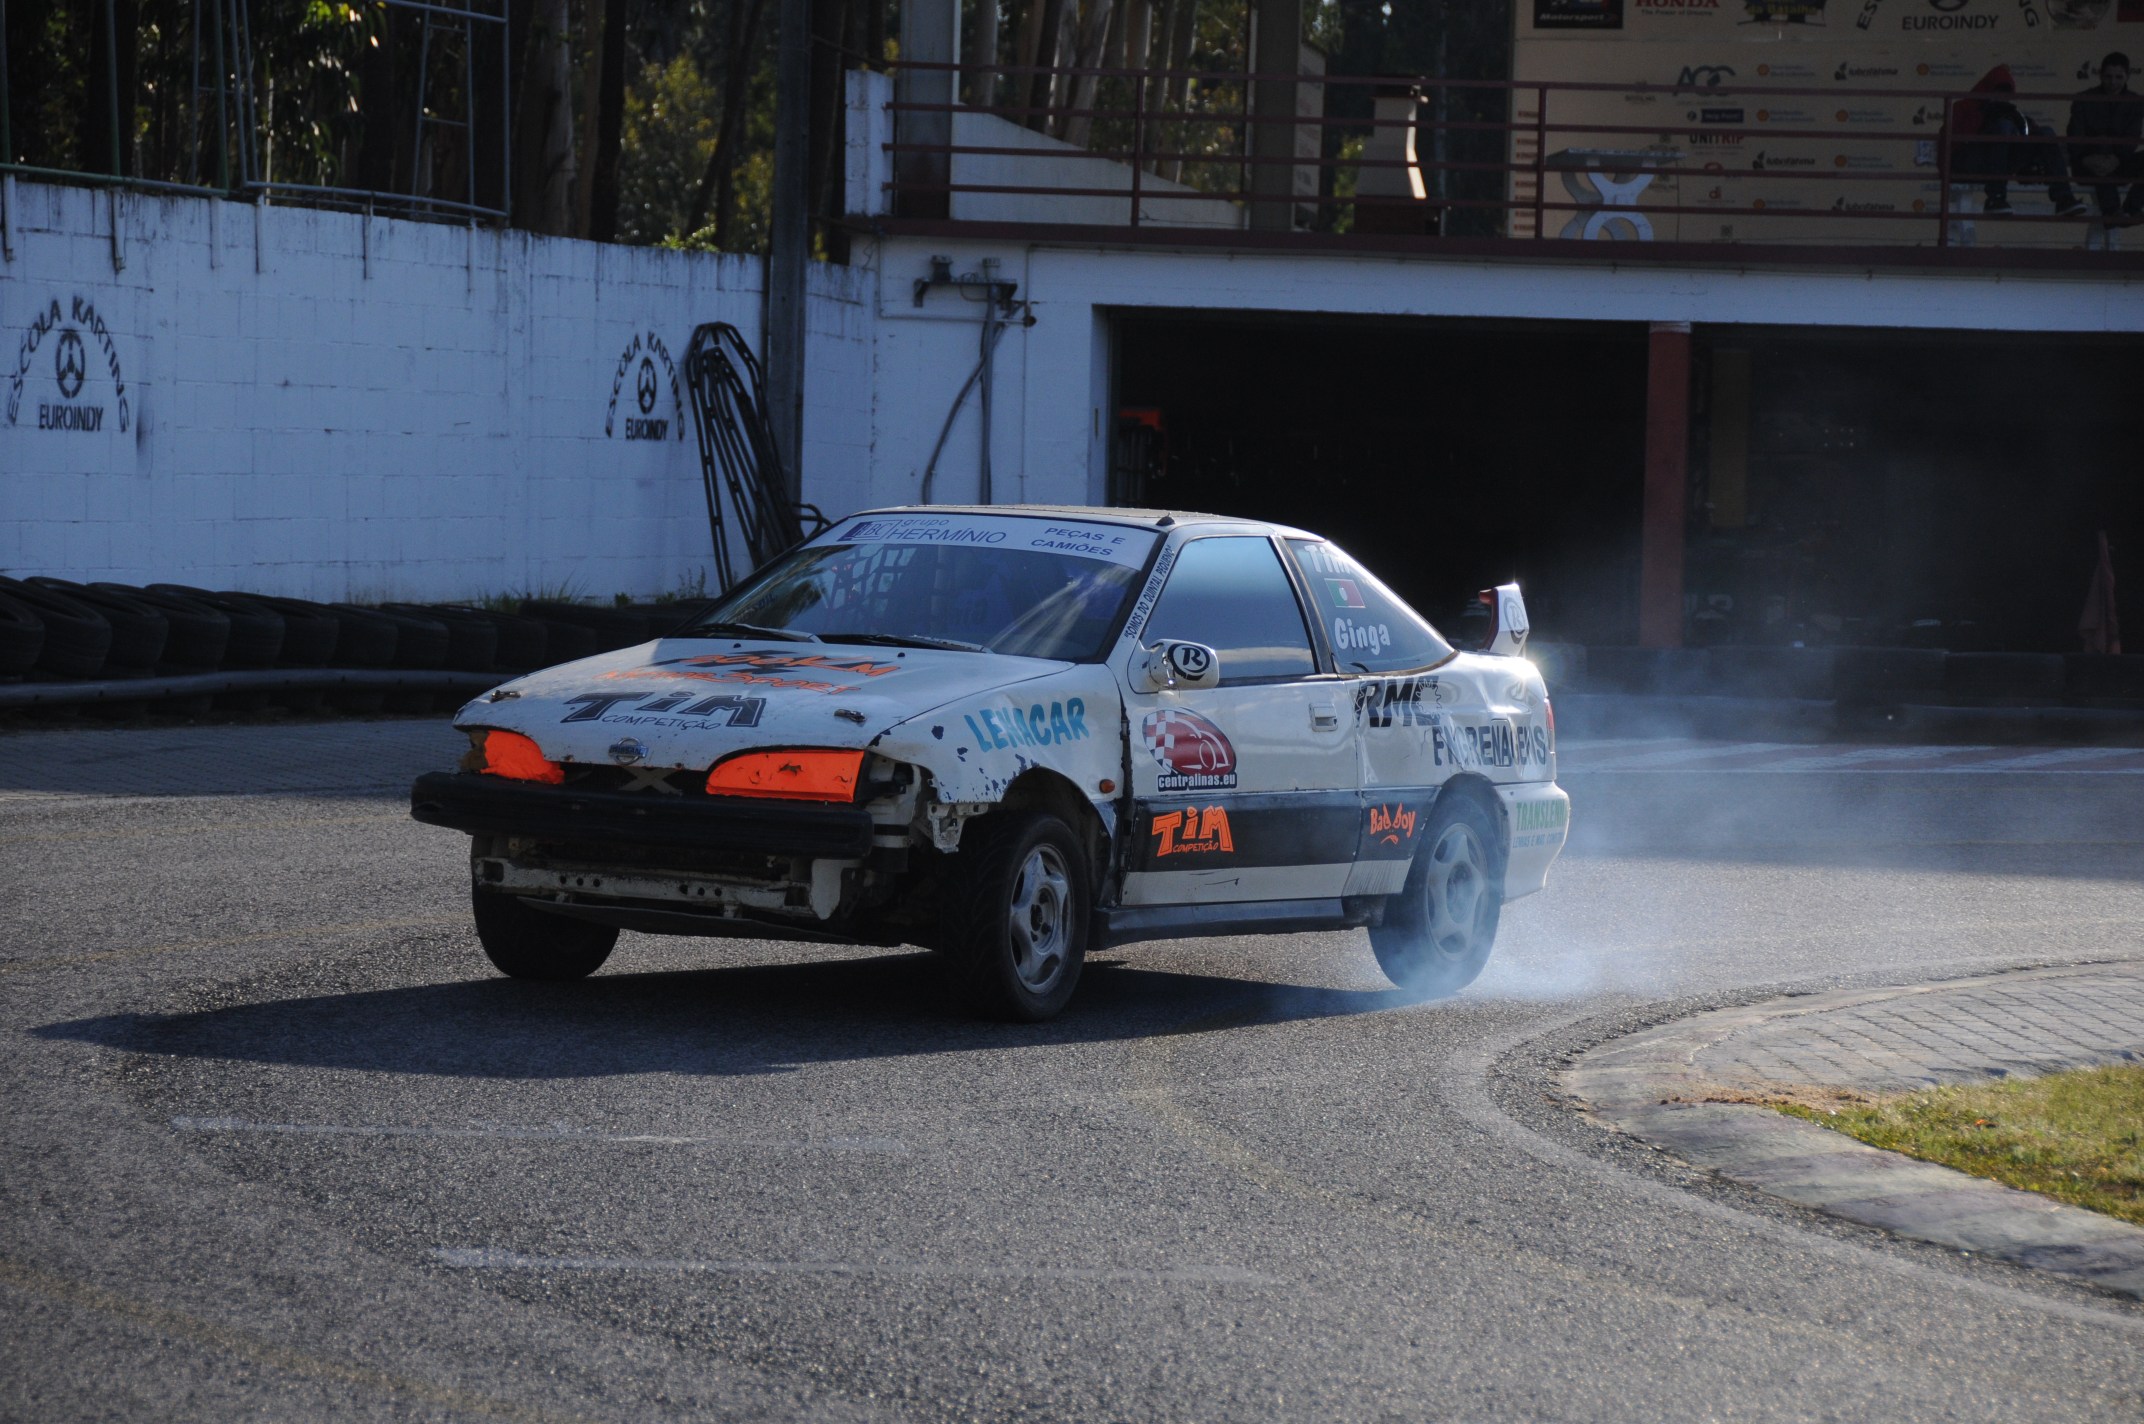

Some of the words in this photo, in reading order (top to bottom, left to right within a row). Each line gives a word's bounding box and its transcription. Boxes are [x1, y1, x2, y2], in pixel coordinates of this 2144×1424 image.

[1539, 13, 1605, 22] Motorsport
[1902, 15, 1999, 30] EUROINDY
[7, 298, 61, 426] ESCOLA
[72, 295, 130, 433] KARTING
[605, 333, 641, 438] ESCOLA
[647, 331, 685, 442] KARTING
[39, 403, 104, 432] EUROINDY
[625, 417, 669, 440] EUROINDY
[900, 519, 950, 528] grupo
[886, 527, 1007, 544] HERMÍNIO
[1044, 527, 1105, 543] PEÇAS
[1110, 537, 1127, 546] E
[1030, 538, 1113, 556] CAMIÕES
[1143, 575, 1163, 603] QUINTAL
[1137, 601, 1150, 615] DO
[1334, 617, 1391, 656] Ginga
[601, 713, 721, 731] COMPETIÇÃO
[1158, 773, 1237, 788] centralinas.eu
[1172, 840, 1220, 853] COMPETIÇÃO
